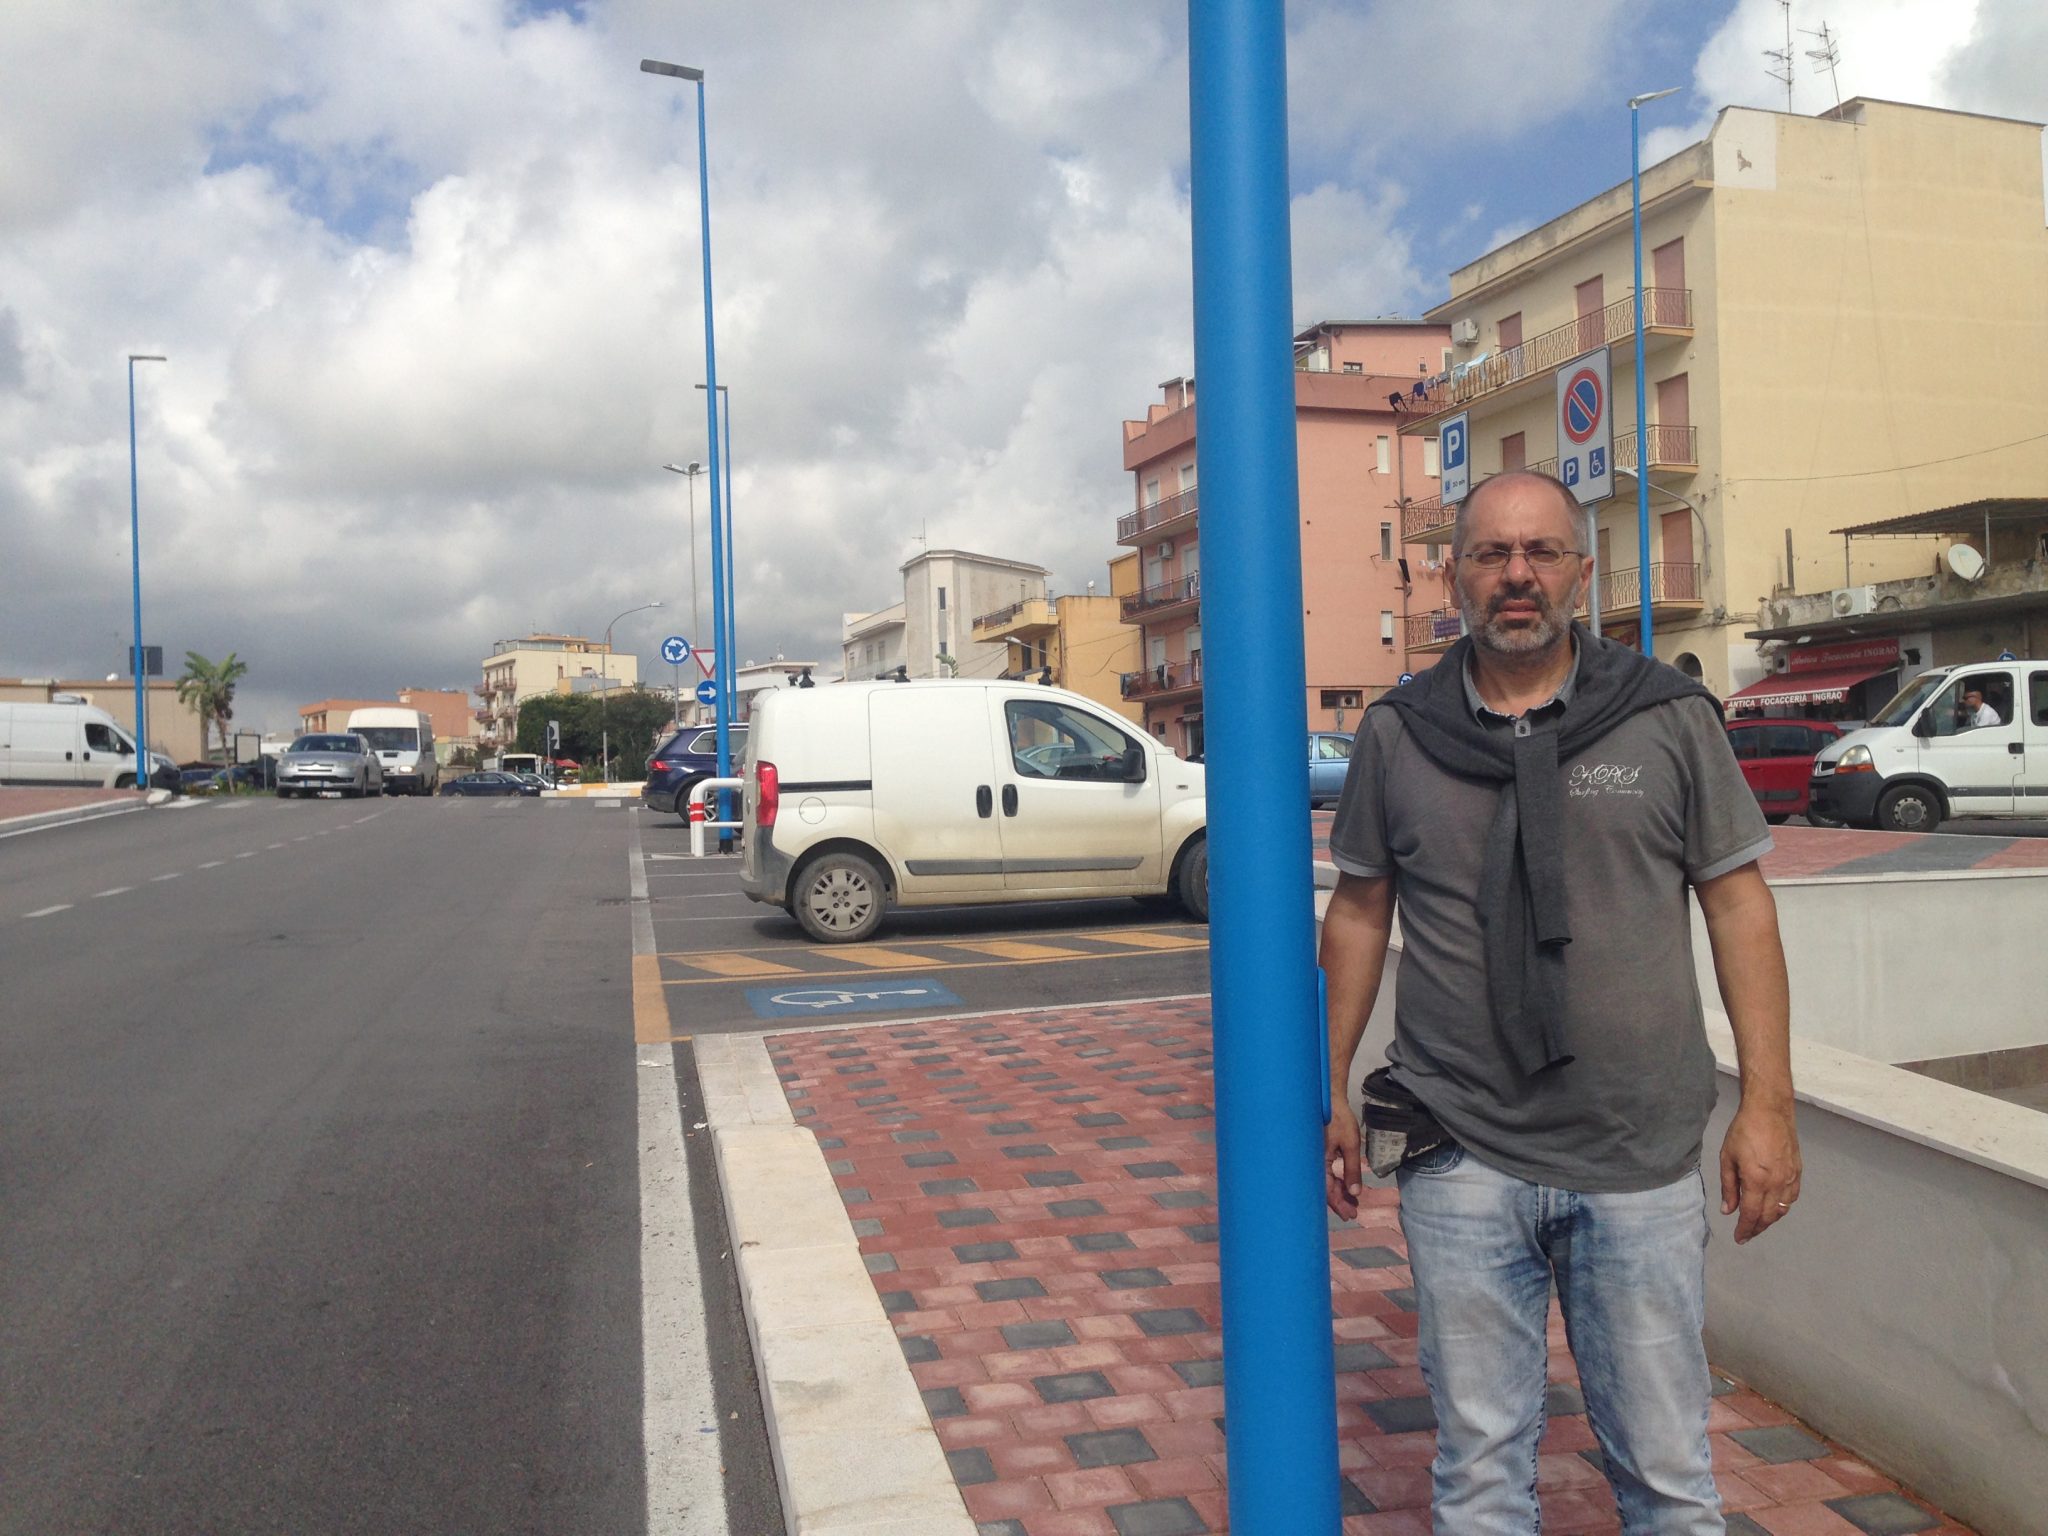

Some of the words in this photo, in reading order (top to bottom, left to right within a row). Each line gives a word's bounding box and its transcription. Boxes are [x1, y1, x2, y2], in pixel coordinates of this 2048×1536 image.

[1447, 429, 1460, 463] P
[1566, 461, 1575, 484] P
[1863, 646, 1898, 657] INGRAO
[1728, 699, 1755, 708] ANTICA
[1760, 694, 1807, 706] FOCACCERIA
[1812, 691, 1842, 701] INGRAO
